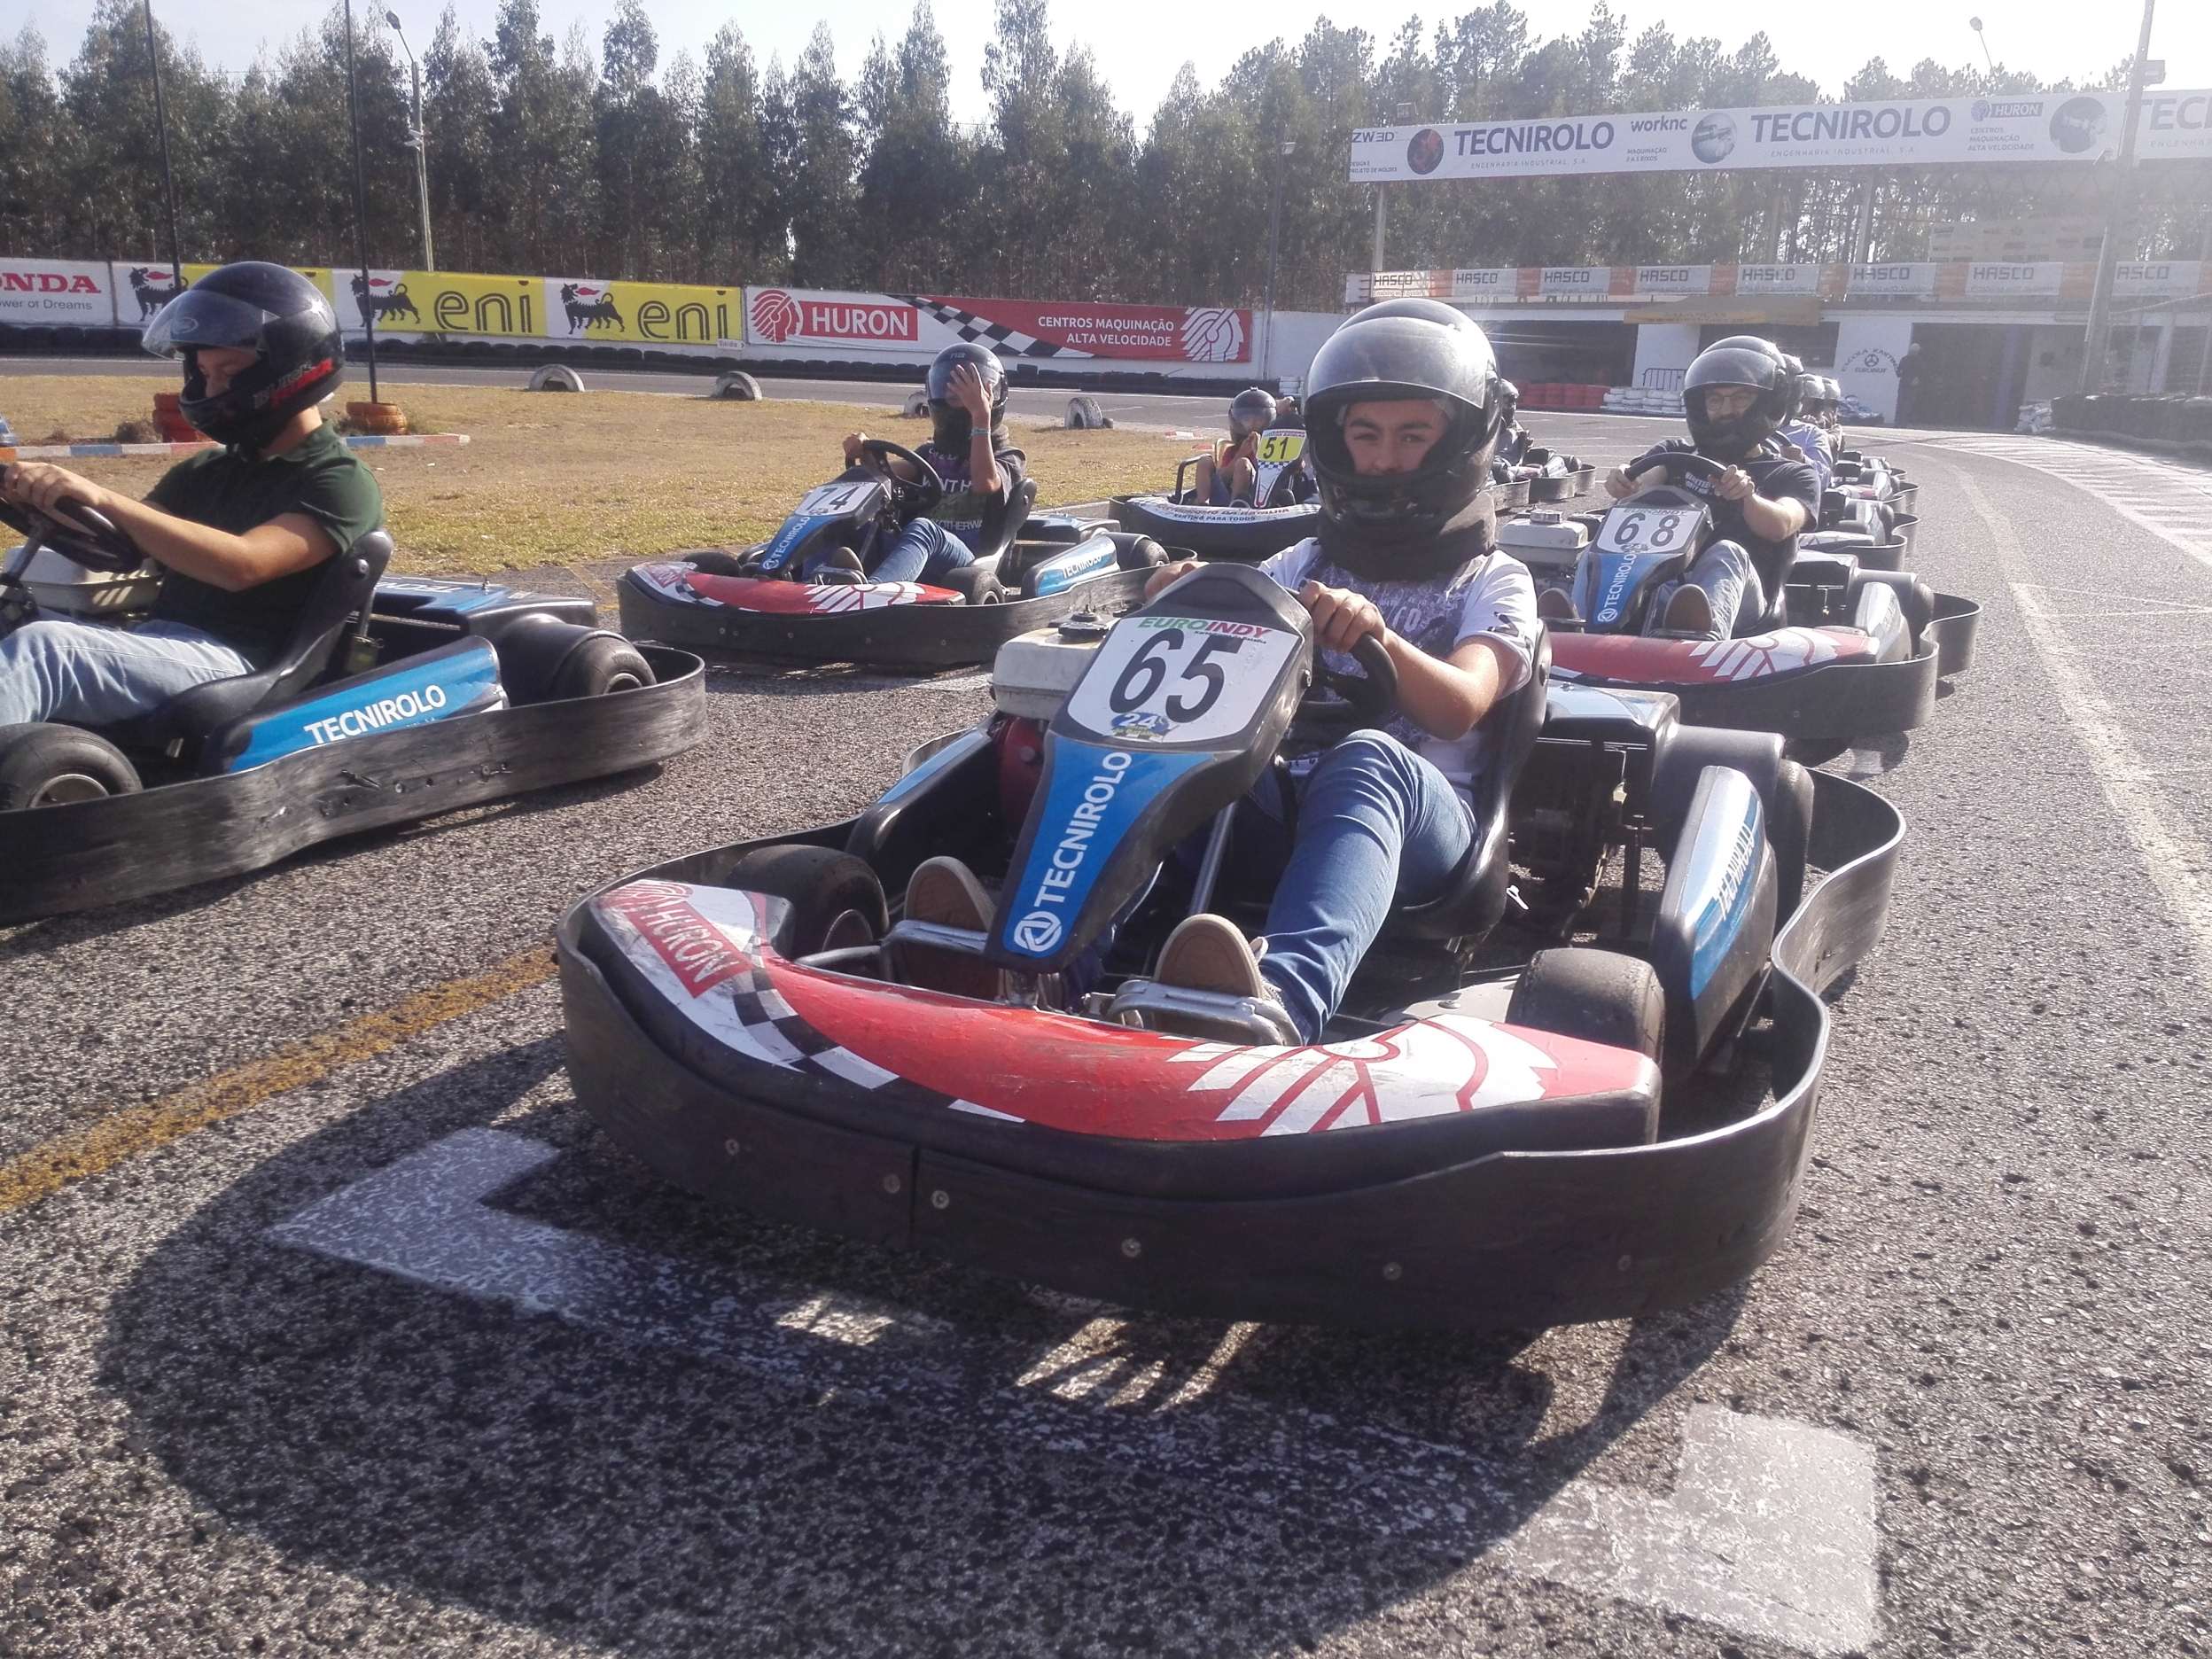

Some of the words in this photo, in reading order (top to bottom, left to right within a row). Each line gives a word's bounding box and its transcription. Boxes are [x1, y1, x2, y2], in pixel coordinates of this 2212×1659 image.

[1995, 105, 2039, 116] HURON
[1630, 115, 1688, 132] worknc
[1751, 105, 1951, 143] TECNIROLO
[1454, 121, 1615, 156] TECNIROLO
[1771, 148, 1830, 158] ENGENHARIA
[1470, 160, 1518, 169] ENGENHARIA
[0, 272, 102, 294] NDA
[1374, 274, 1414, 286] HASCO
[1456, 272, 1498, 284] HASCO
[1544, 270, 1590, 284] HASCO
[1639, 269, 1689, 283] HASCO
[1741, 268, 1795, 282] HASCO
[1852, 267, 1911, 281] HASCO
[1973, 266, 2035, 281] HASCO
[2116, 265, 2170, 280] ASCO
[27, 299, 39, 308] of
[43, 298, 93, 311] Dreams
[433, 279, 532, 333] eni
[637, 290, 728, 340] eni
[812, 307, 909, 337] HURON
[1037, 315, 1093, 329] CENTROS
[1095, 315, 1175, 333] MAQUINAÇÃO
[1066, 332, 1097, 344] ALTA
[1099, 333, 1172, 347] VELOCIDADE
[1263, 436, 1289, 460] 51
[806, 485, 861, 511] 74
[774, 517, 811, 560] TECNIROLO
[1614, 512, 1681, 548] 68
[1605, 553, 1638, 609] TECNIROLO
[1139, 617, 1273, 638] EUROINDY
[1109, 627, 1246, 723] 65
[303, 685, 447, 744] TECNIROLO
[1034, 752, 1134, 907] TECNIROLO
[639, 907, 740, 984] HURON
